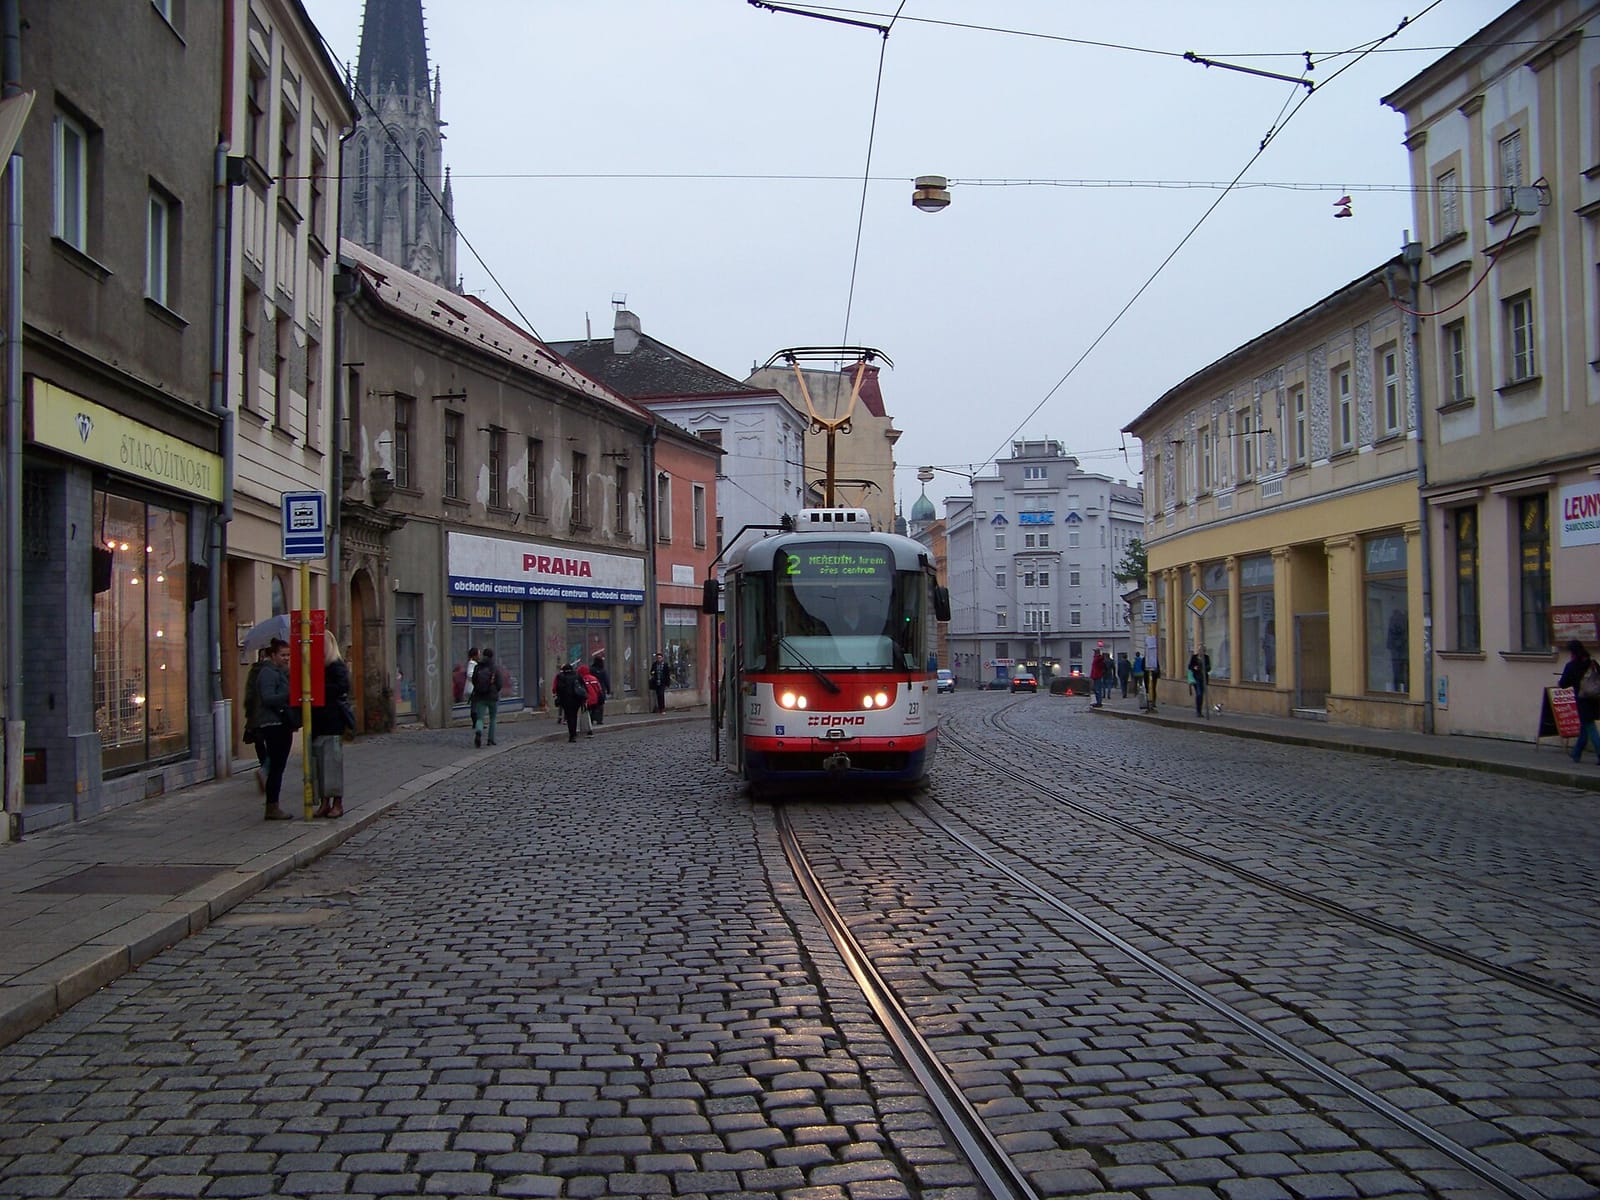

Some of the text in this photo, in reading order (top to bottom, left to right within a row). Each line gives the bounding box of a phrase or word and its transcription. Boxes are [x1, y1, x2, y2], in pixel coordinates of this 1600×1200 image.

[120, 434, 211, 491] STAROŽITNOSTI
[522, 554, 592, 577] PRAHA
[786, 554, 801, 575] 2
[842, 566, 875, 574] centrum
[454, 581, 493, 592] obchodní
[494, 585, 526, 595] centrum
[529, 586, 561, 597] obchodní
[561, 589, 588, 598] centrum
[620, 593, 643, 601] centrum
[908, 702, 919, 715] 237
